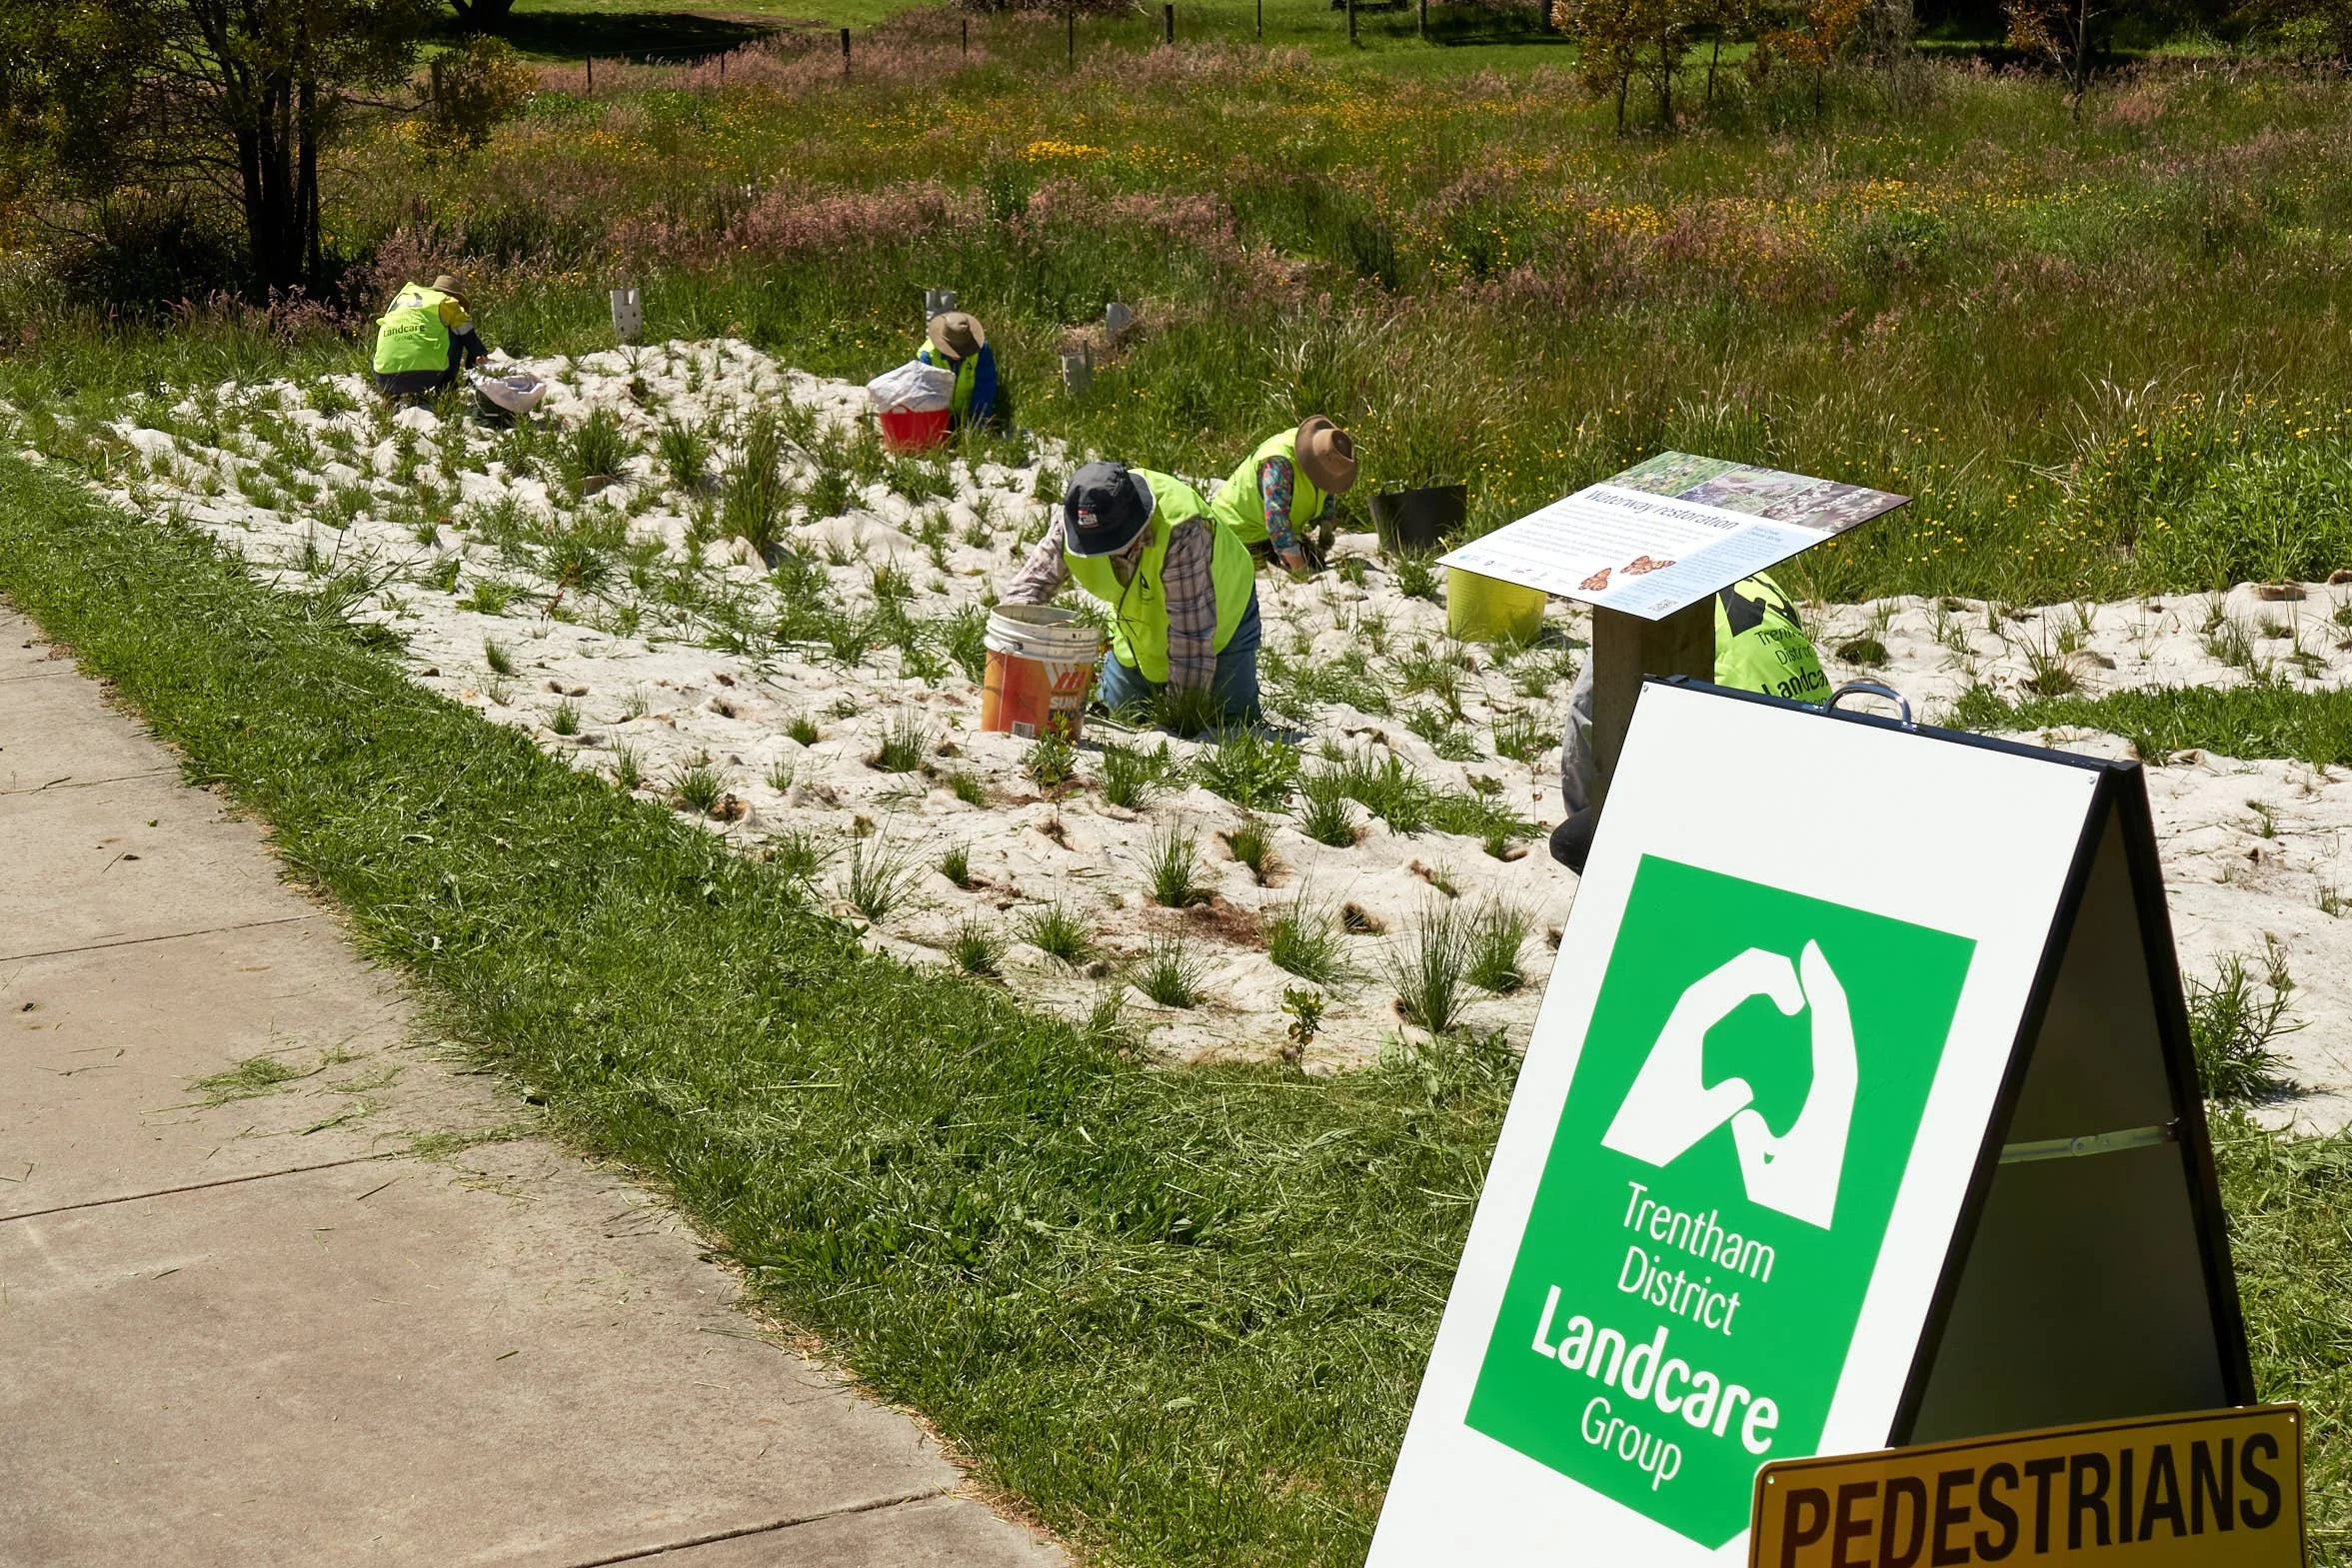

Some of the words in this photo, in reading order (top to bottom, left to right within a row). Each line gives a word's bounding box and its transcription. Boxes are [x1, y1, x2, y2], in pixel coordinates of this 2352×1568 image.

[383, 325, 425, 337] Landcare
[1585, 490, 1653, 514] Waterway
[1654, 505, 1740, 531] restoration
[1775, 645, 1814, 666] Distric
[1050, 695, 1078, 710] SUN
[1623, 1180, 1775, 1283] Trentham
[1617, 1245, 1740, 1336] District
[1531, 1284, 1778, 1455] Landcare
[1581, 1396, 1682, 1492] Group
[1779, 1432, 2280, 1568] PEDESTRIANS
